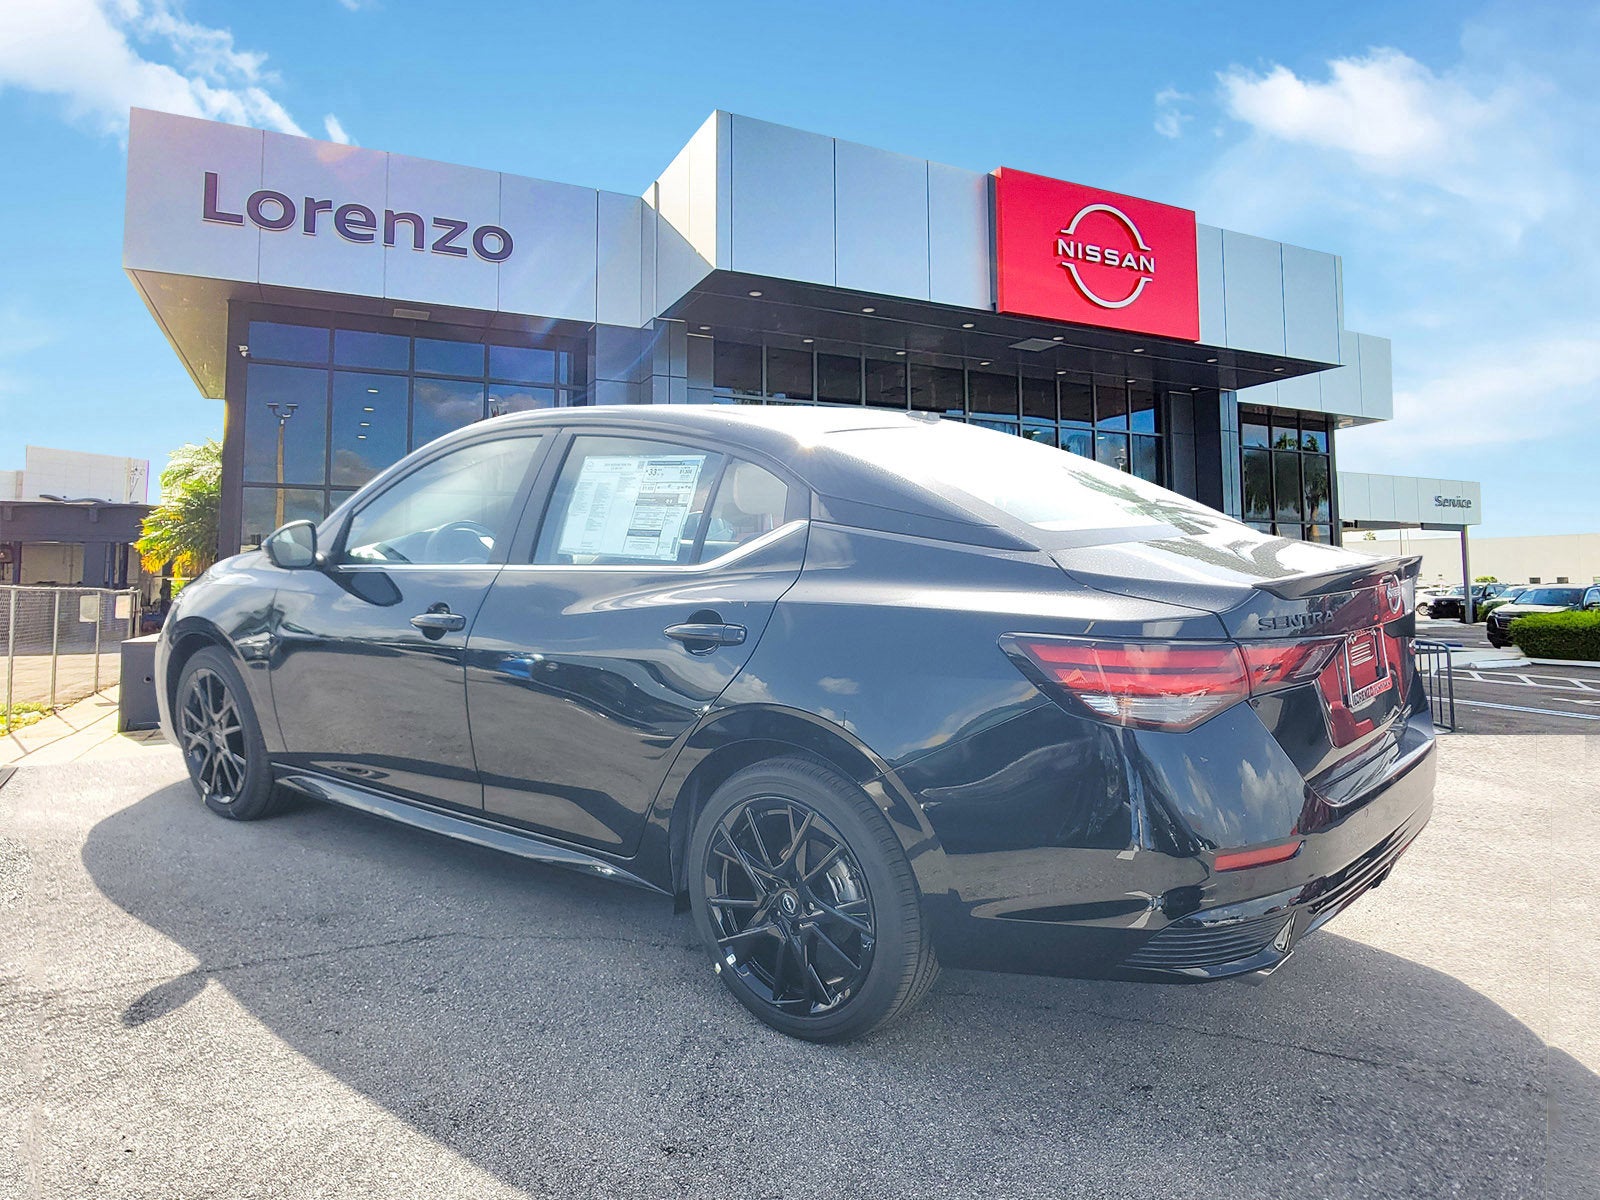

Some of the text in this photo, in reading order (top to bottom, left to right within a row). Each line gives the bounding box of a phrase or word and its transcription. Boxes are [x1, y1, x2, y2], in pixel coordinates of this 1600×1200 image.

[202, 171, 514, 262] Lorenzo
[1057, 238, 1155, 273] NISSAN
[1434, 495, 1472, 508] Service
[1258, 610, 1335, 631] SENTRA
